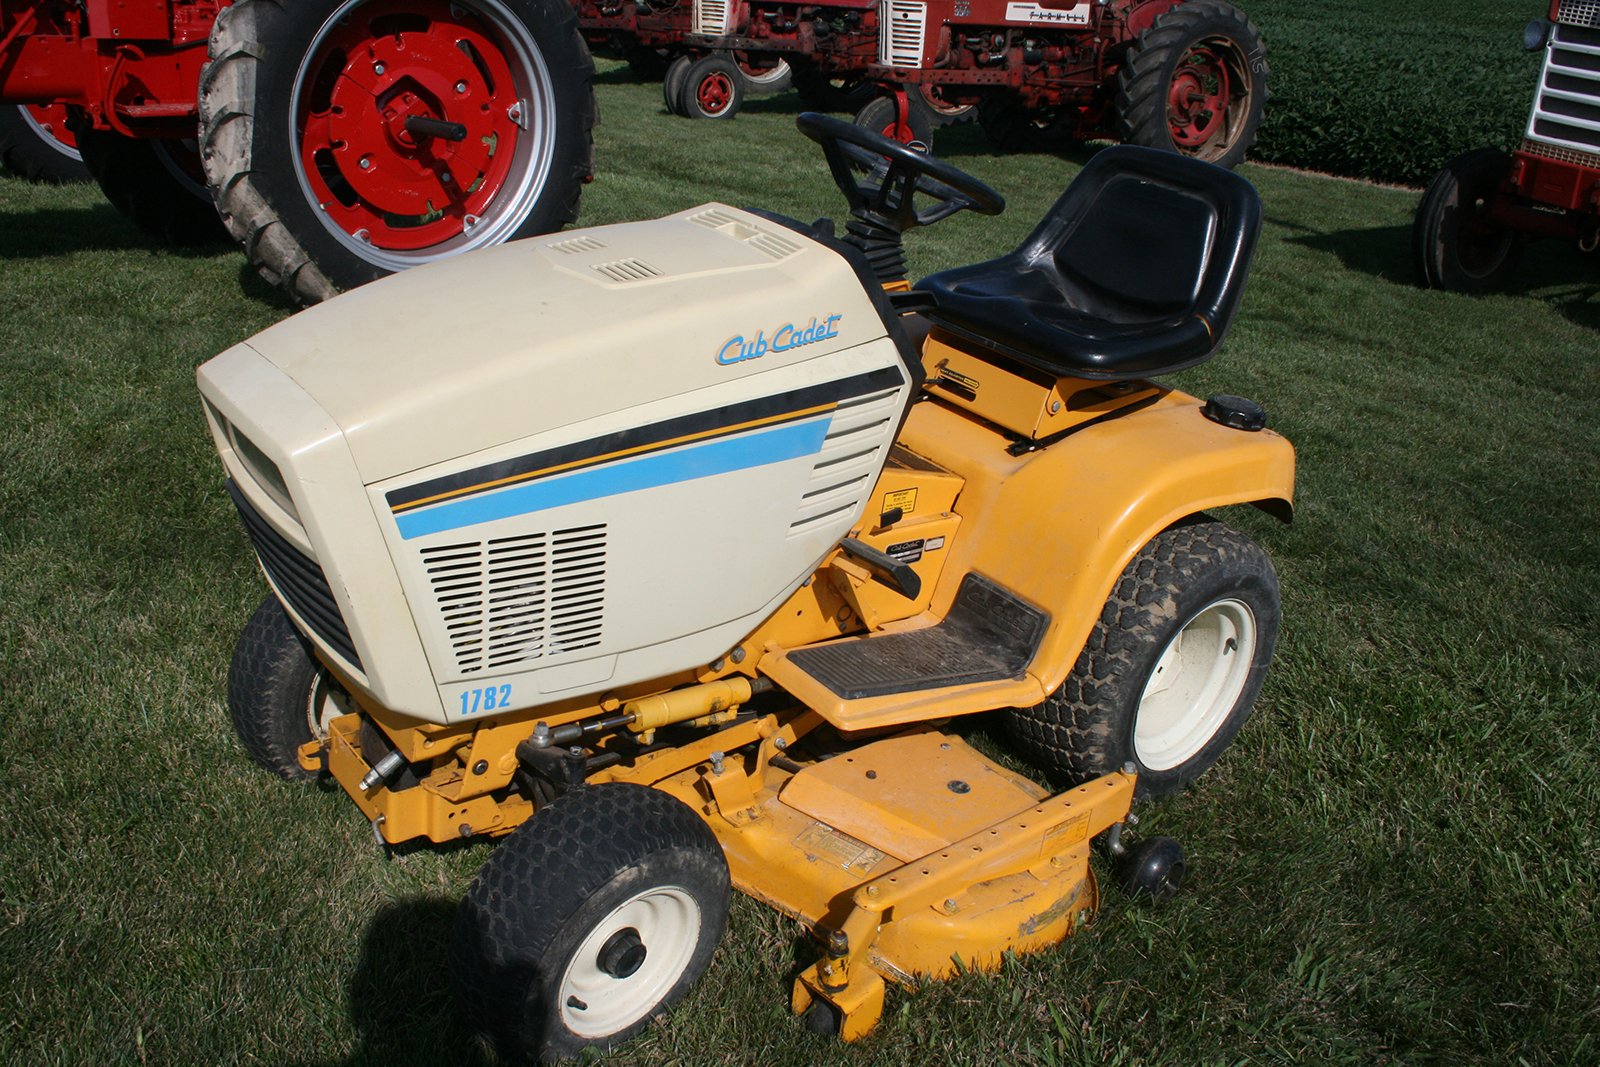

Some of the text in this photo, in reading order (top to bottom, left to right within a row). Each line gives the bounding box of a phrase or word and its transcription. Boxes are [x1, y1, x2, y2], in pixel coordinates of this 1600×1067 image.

[715, 313, 843, 366] Cub Cadet
[460, 684, 512, 715] 1782
